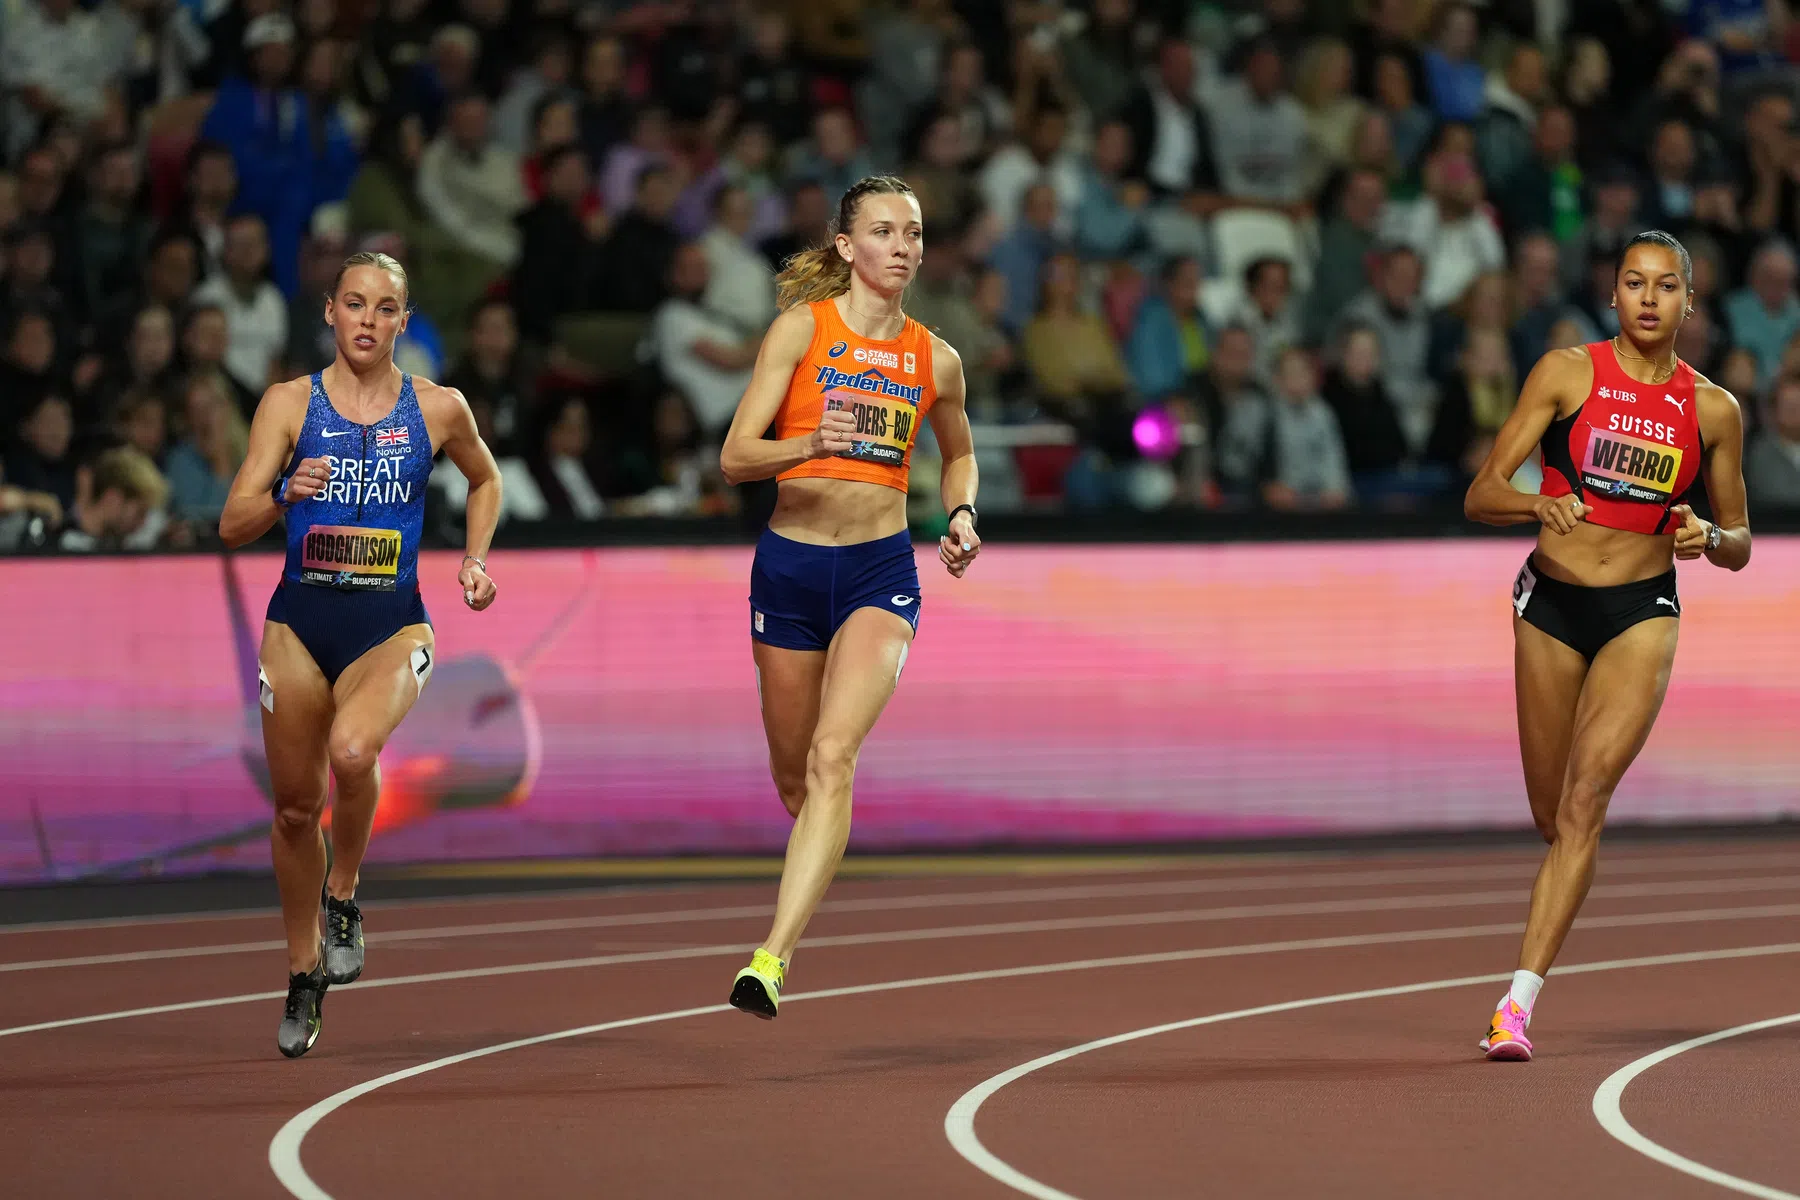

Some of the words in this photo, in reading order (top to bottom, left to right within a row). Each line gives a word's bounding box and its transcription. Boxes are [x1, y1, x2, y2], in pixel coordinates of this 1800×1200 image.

[868, 350, 898, 361] STAATS
[1612, 390, 1637, 403] UBS
[376, 446, 411, 457] Novuna
[1591, 437, 1675, 484] WERRO
[328, 455, 405, 482] GREAT
[313, 481, 411, 505] BRITAIN
[1585, 476, 1612, 490] ULTIMATE
[1628, 488, 1657, 501] BUDAPEST
[306, 533, 398, 567] HODGKINSON
[307, 572, 333, 582] ULTIMATE
[352, 577, 381, 586] BUDAPEST
[1513, 570, 1527, 601] 5
[416, 647, 430, 676] 7
